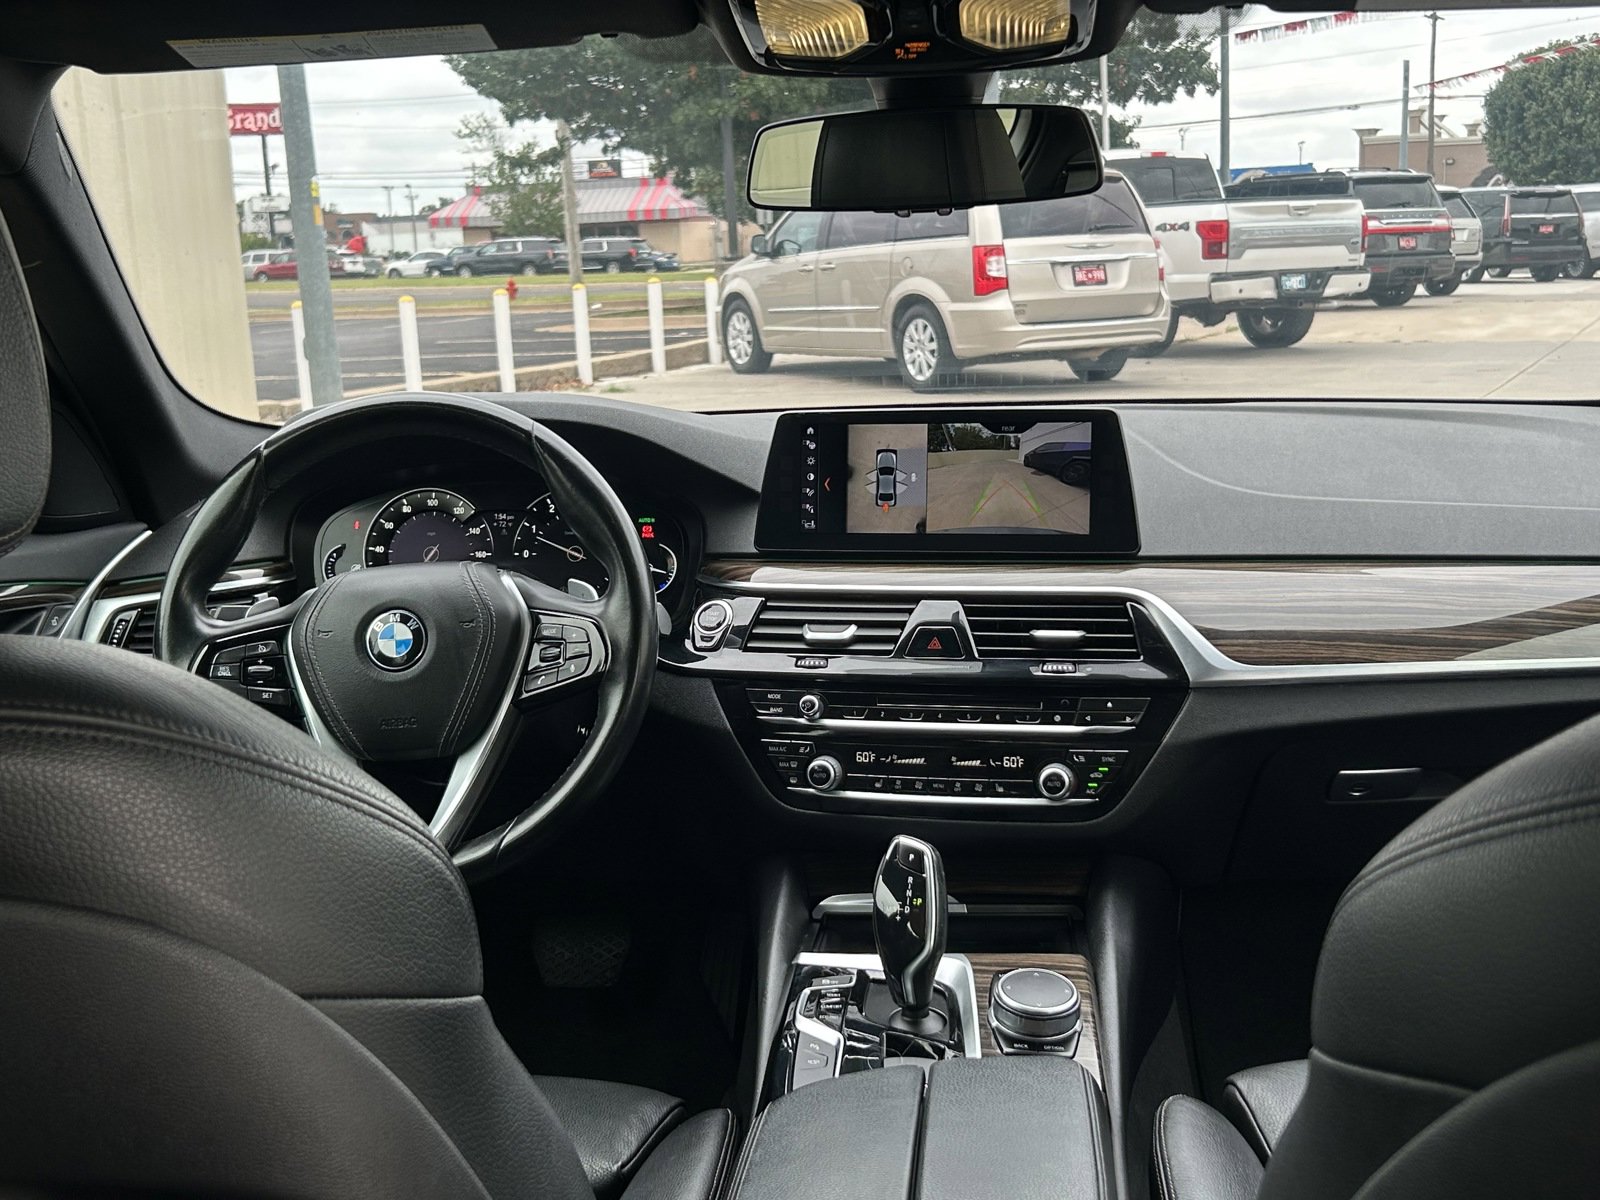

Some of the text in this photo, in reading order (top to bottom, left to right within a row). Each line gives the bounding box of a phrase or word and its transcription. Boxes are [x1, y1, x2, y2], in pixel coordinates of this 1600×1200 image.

[426, 498, 438, 506] 100
[402, 505, 412, 513] 80
[548, 504, 555, 513] 2
[384, 521, 394, 530] 60
[532, 524, 536, 534] 1
[468, 527, 480, 535] 140
[374, 545, 384, 553] 40
[474, 550, 487, 558] 160
[523, 550, 530, 558] 0
[373, 613, 419, 632] BMW
[380, 718, 418, 730] AIRBAG
[908, 853, 914, 861] P
[908, 876, 914, 884] R
[917, 898, 922, 906] P
[904, 906, 910, 914] D
